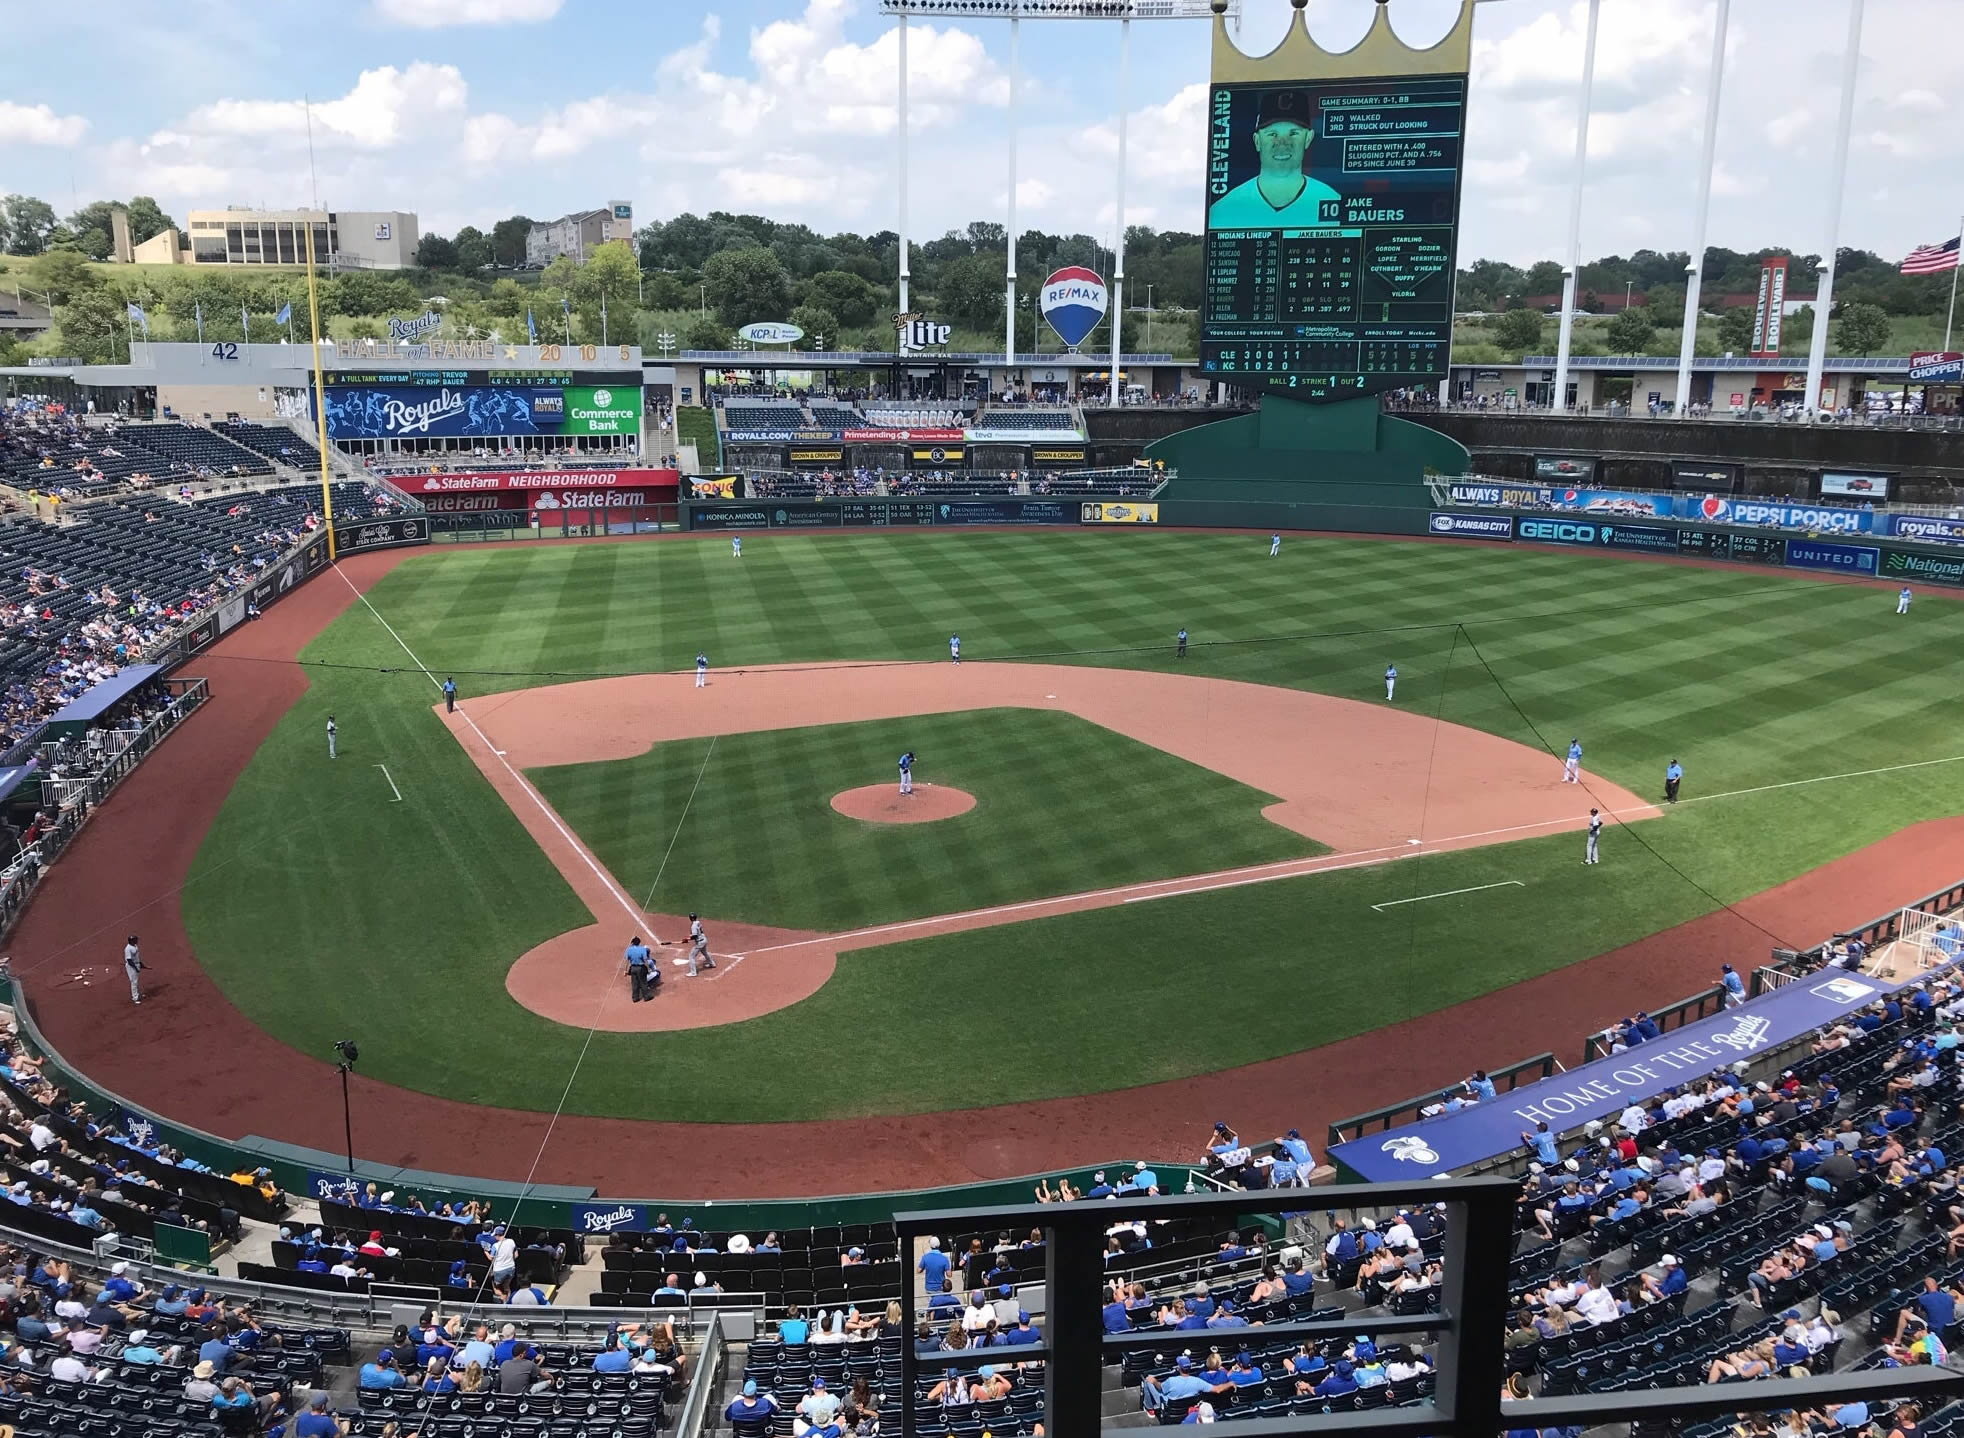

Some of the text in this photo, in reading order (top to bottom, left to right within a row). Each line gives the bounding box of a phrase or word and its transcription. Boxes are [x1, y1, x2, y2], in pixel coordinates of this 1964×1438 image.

[1342, 97, 1380, 105] SUMMARY:
[1349, 123, 1378, 131] STRUCK
[1395, 121, 1428, 129] LOOKING
[1212, 90, 1232, 194] CLEVELAND
[1348, 152, 1384, 160] SLUGGING
[1345, 198, 1373, 207] JAKE
[1321, 203, 1339, 217] 10
[1348, 210, 1404, 222] BAUERS
[1050, 288, 1099, 302] RE/MAX
[1752, 274, 1768, 345] BOULEVARD
[1768, 274, 1782, 345] BOULEVARD
[388, 310, 442, 342] Royals
[892, 312, 923, 329] Miller
[904, 320, 950, 350] Lite
[212, 342, 238, 360] 42
[336, 339, 496, 361] HALL of FAME
[540, 345, 561, 361] 20
[579, 345, 596, 361] 10
[620, 345, 629, 361] 5
[1220, 351, 1299, 359] CLE 3 0 0 1 1
[1223, 362, 1287, 370] KC 1 0 2 0
[1913, 353, 1944, 366] PRICE
[1910, 362, 1960, 378] CHOPPER
[1289, 376, 1296, 387] 2
[1330, 376, 1336, 387] 1
[1357, 376, 1364, 387] 2
[384, 388, 465, 434] Royals
[535, 404, 557, 412] ROYAL
[571, 408, 633, 419] Commerce
[589, 420, 618, 430] Bank
[845, 432, 896, 440] PrimeLending
[932, 451, 944, 460] BC
[508, 474, 616, 487] NEIGHBORHOOD
[694, 483, 734, 492] SONIC
[1451, 488, 1537, 502] ALWAYS ROYAL
[1735, 505, 1859, 530] PEPSI PORCH
[1455, 520, 1489, 530] KANSAS
[1490, 522, 1509, 531] CITY
[1519, 522, 1595, 542] GEICO
[370, 535, 395, 544] COMPANY
[1626, 532, 1659, 540] UNIVERSITY
[1792, 550, 1853, 564] UNITED
[1905, 557, 1964, 575] National
[1513, 1014, 1771, 1125] HOME OF THE Royals
[128, 1118, 154, 1135] Royals
[584, 1205, 636, 1232] Royals
